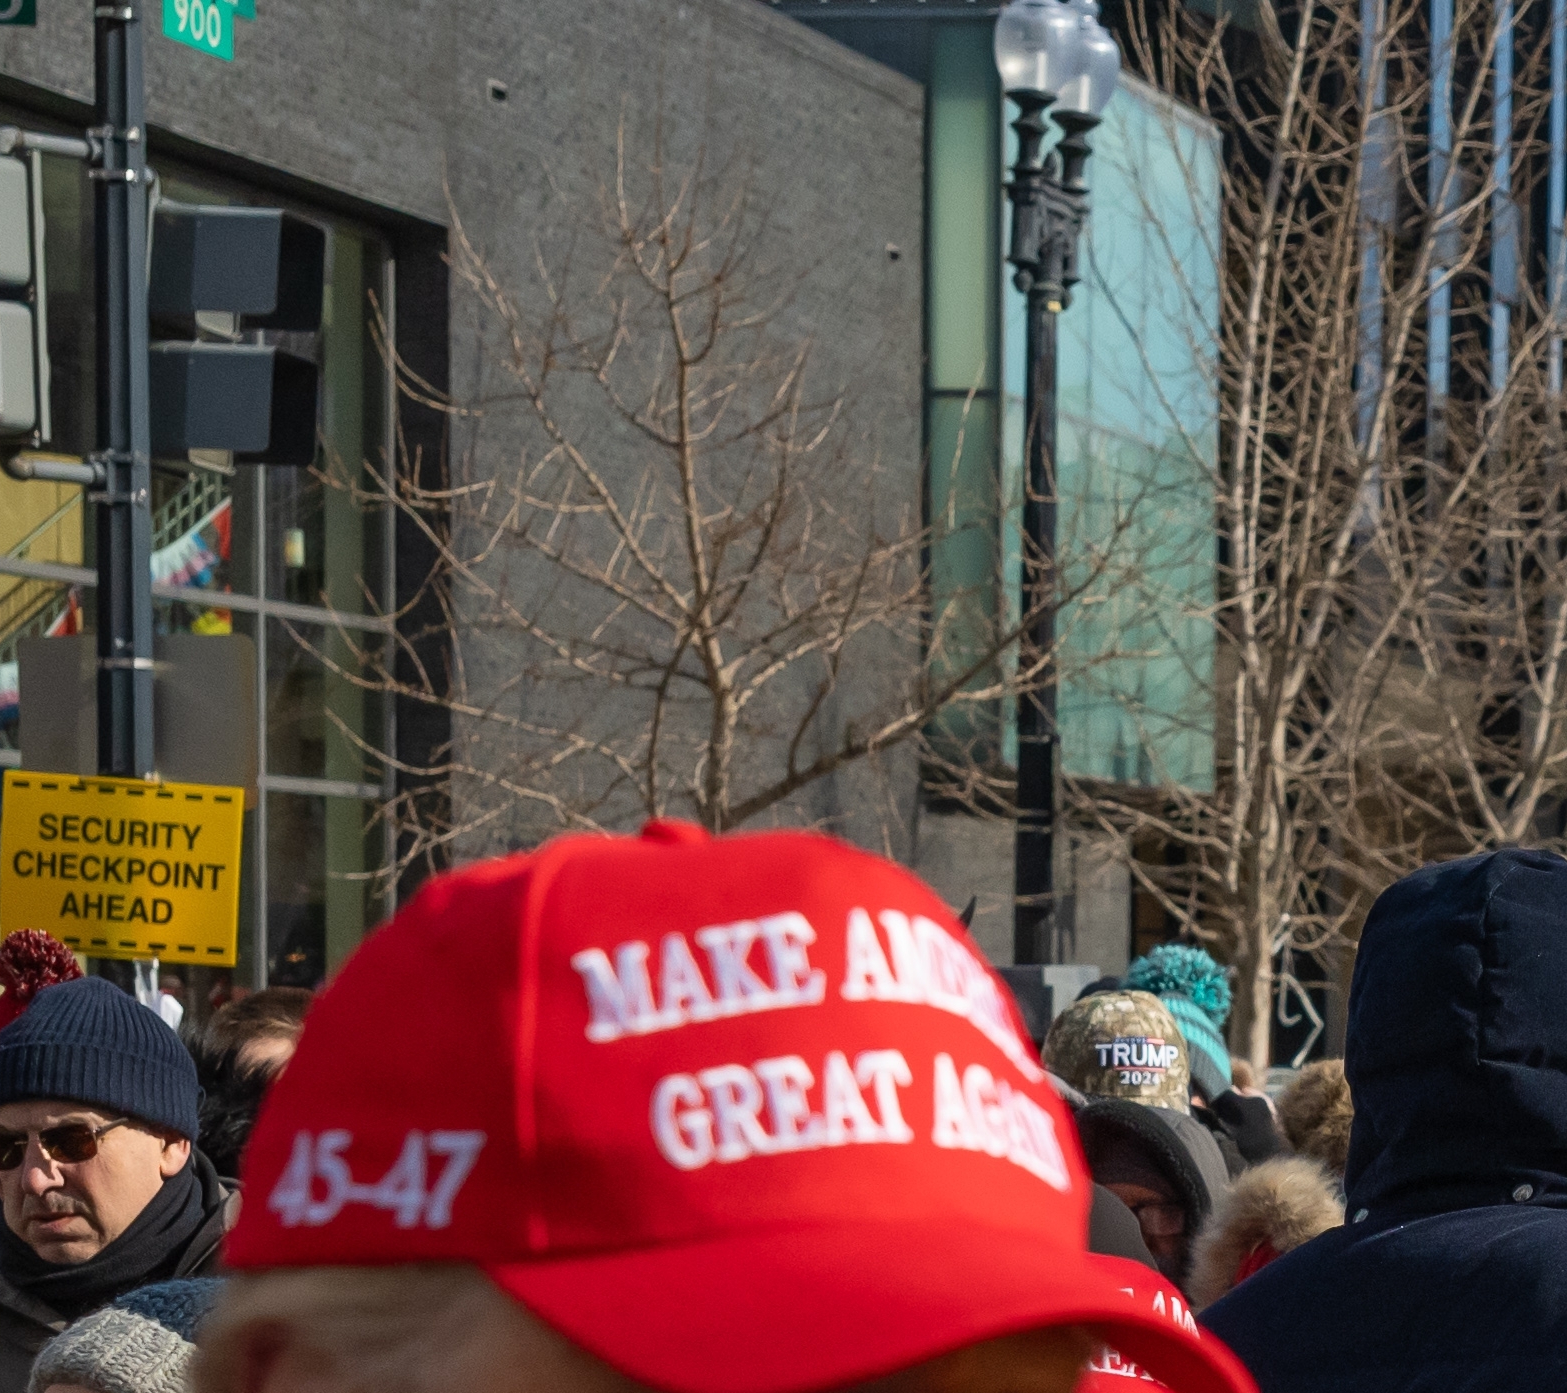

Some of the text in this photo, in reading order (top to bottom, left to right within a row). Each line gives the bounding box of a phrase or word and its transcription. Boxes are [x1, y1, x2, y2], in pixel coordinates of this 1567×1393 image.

[174, 0, 221, 48] 900
[39, 813, 202, 850] SECURITY
[13, 850, 226, 890] CHECKPOINT
[60, 891, 173, 925] AHEAD
[571, 911, 827, 1043] MAKE
[1095, 1043, 1178, 1068] TRUMP
[1120, 1071, 1160, 1085] 2024
[649, 1050, 914, 1171] GREAT
[267, 1128, 488, 1230] 45-47
